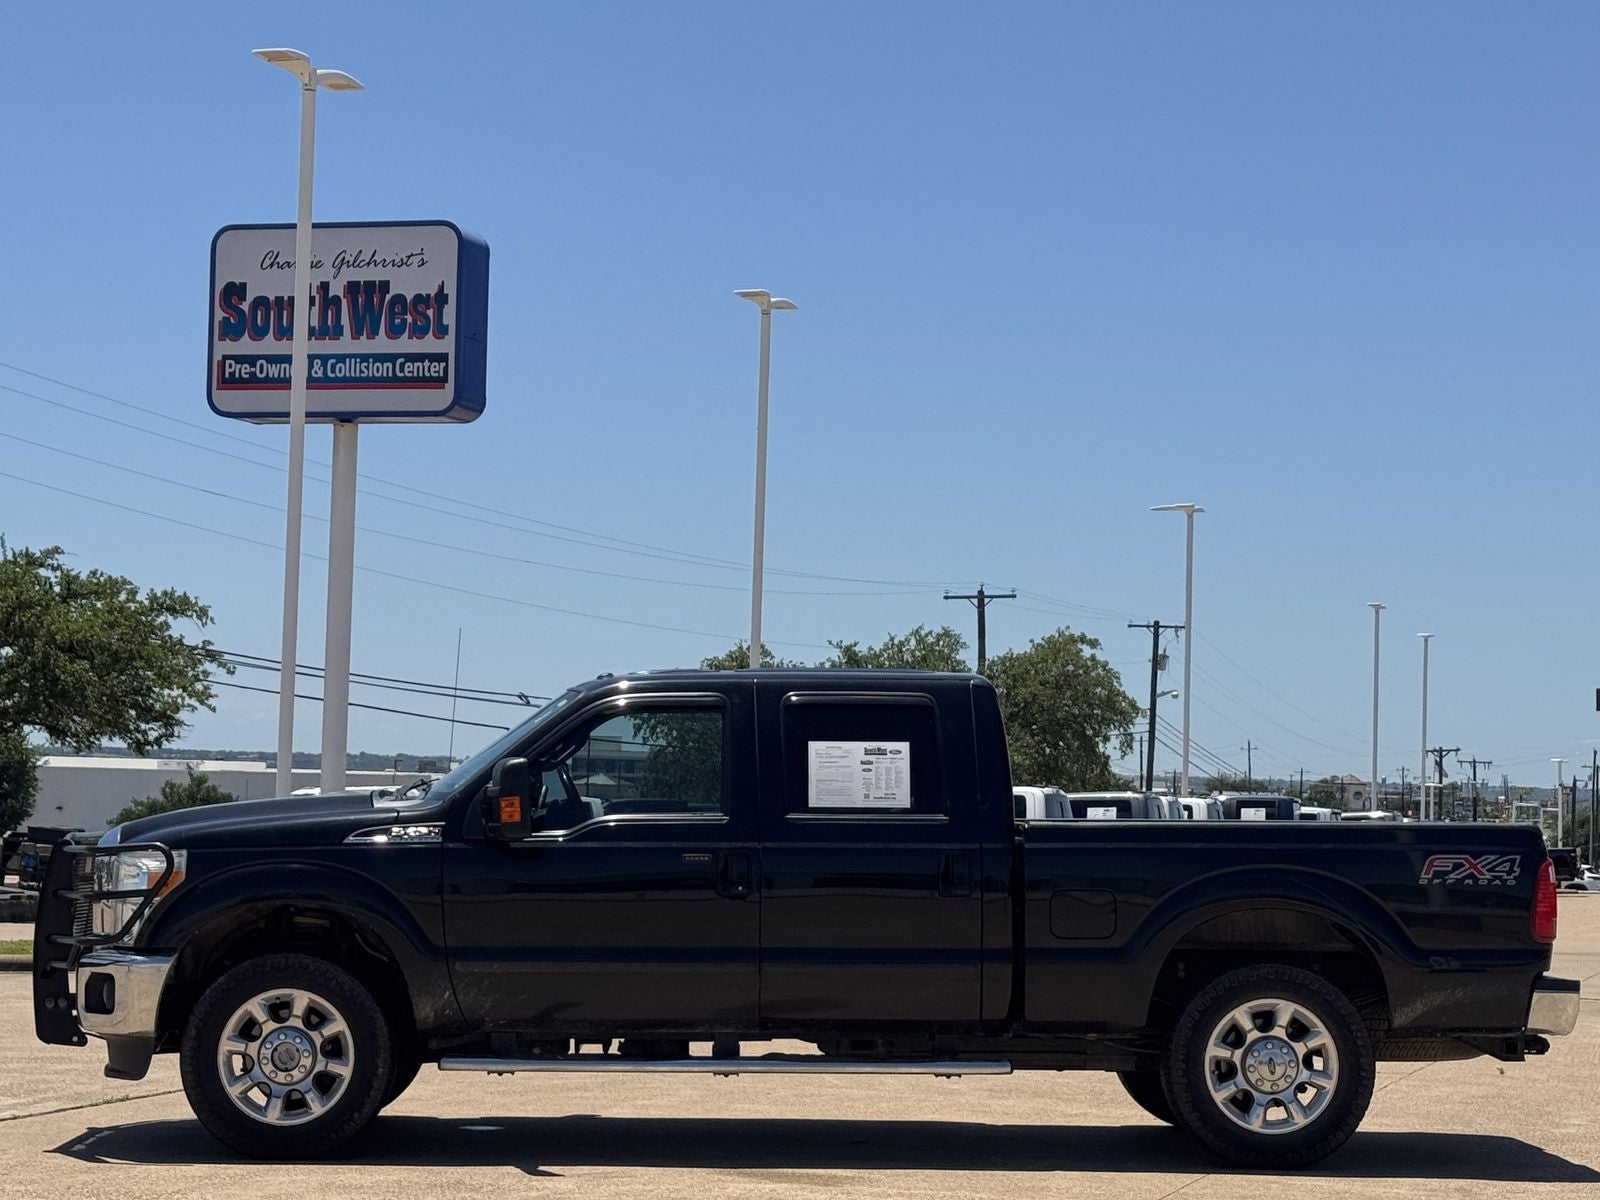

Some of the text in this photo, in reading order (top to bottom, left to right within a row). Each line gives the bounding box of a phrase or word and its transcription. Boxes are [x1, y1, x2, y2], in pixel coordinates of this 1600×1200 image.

[260, 247, 428, 280] Chaie Gilchrist's
[311, 359, 324, 378] &
[326, 358, 393, 379] Collision
[395, 358, 446, 378] Center
[1420, 854, 1522, 879] FX4
[1464, 878, 1516, 886] ROAD
